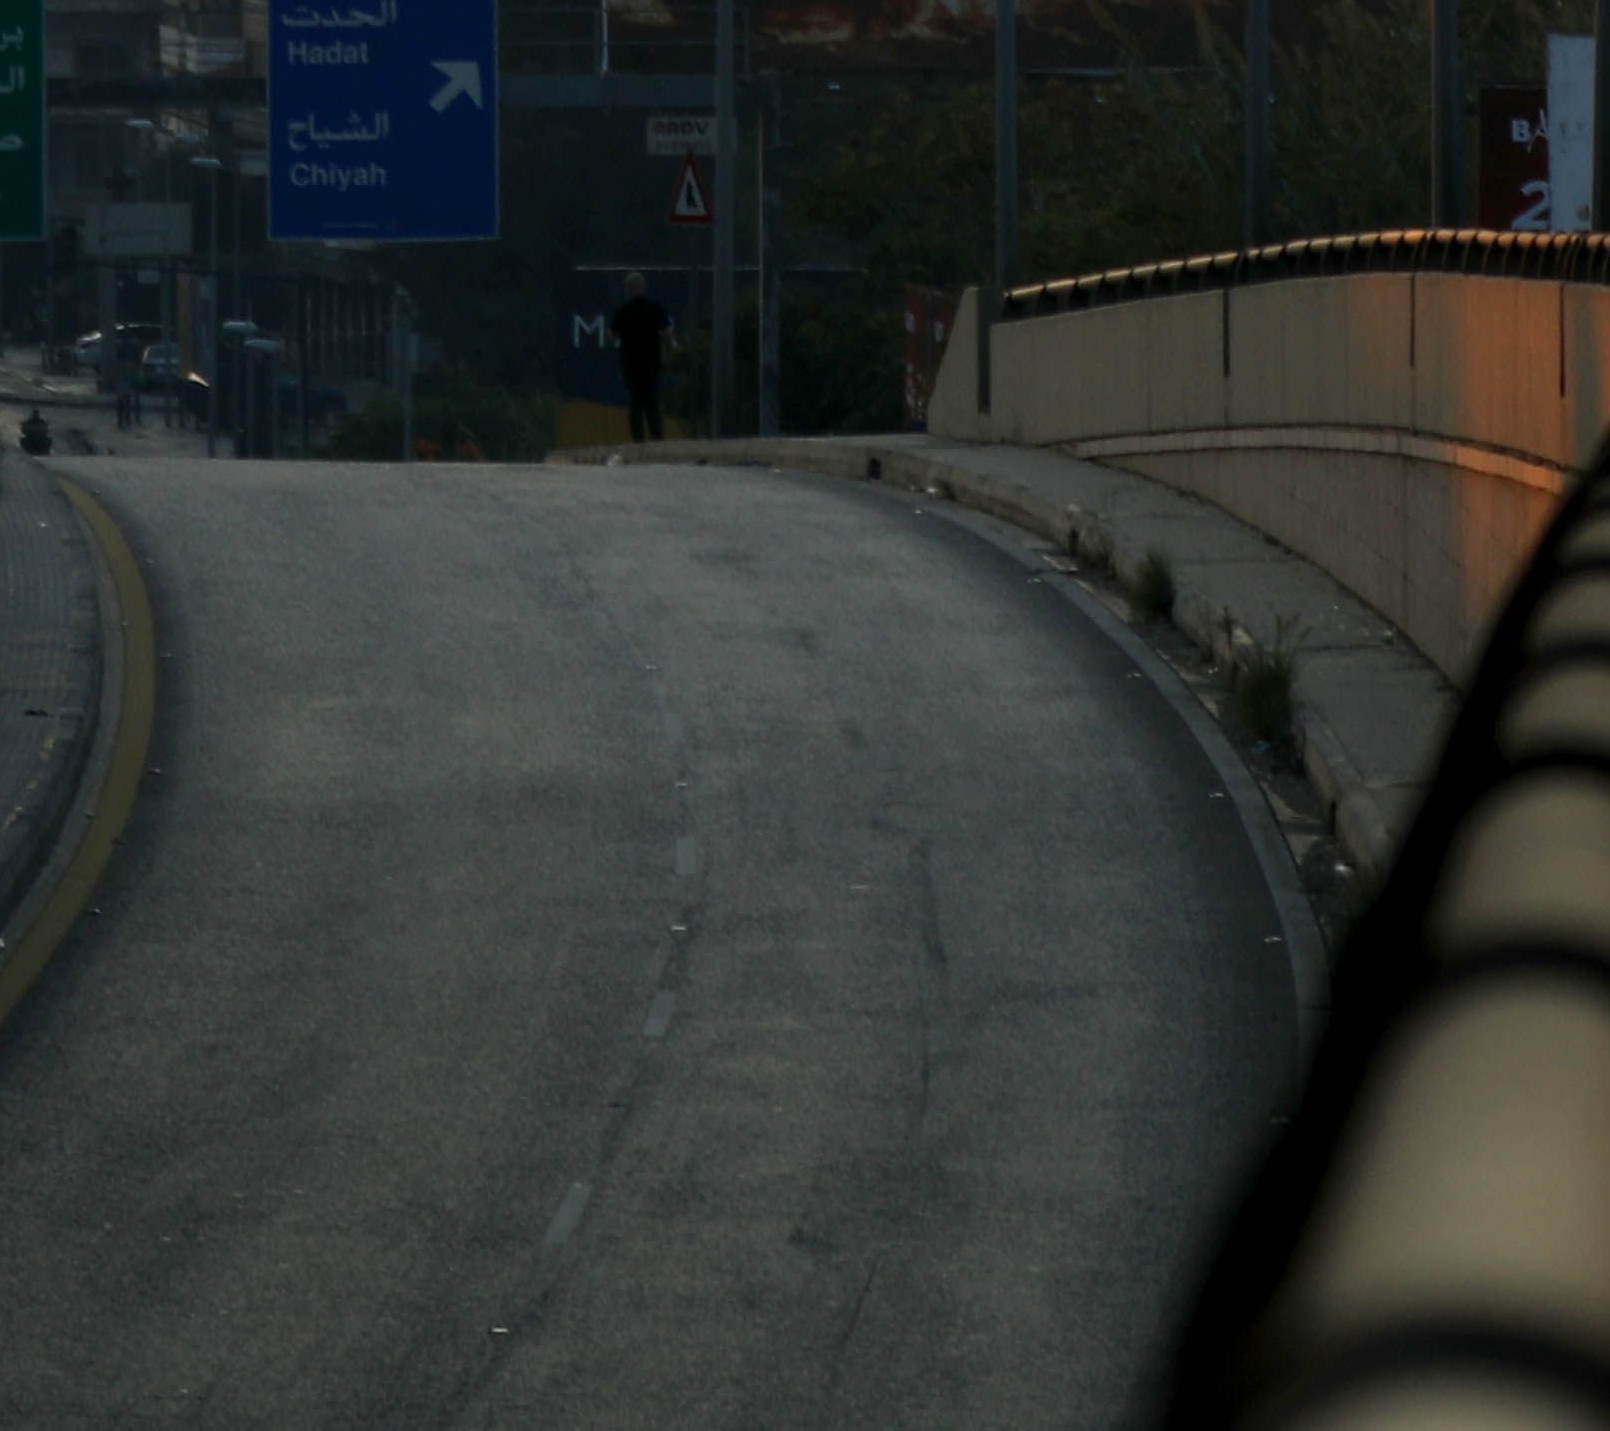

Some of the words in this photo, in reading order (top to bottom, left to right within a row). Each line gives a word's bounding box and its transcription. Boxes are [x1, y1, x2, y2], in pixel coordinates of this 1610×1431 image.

[287, 40, 370, 66] Hadat
[286, 109, 390, 152] الشياح
[289, 161, 389, 193] Chiyah
